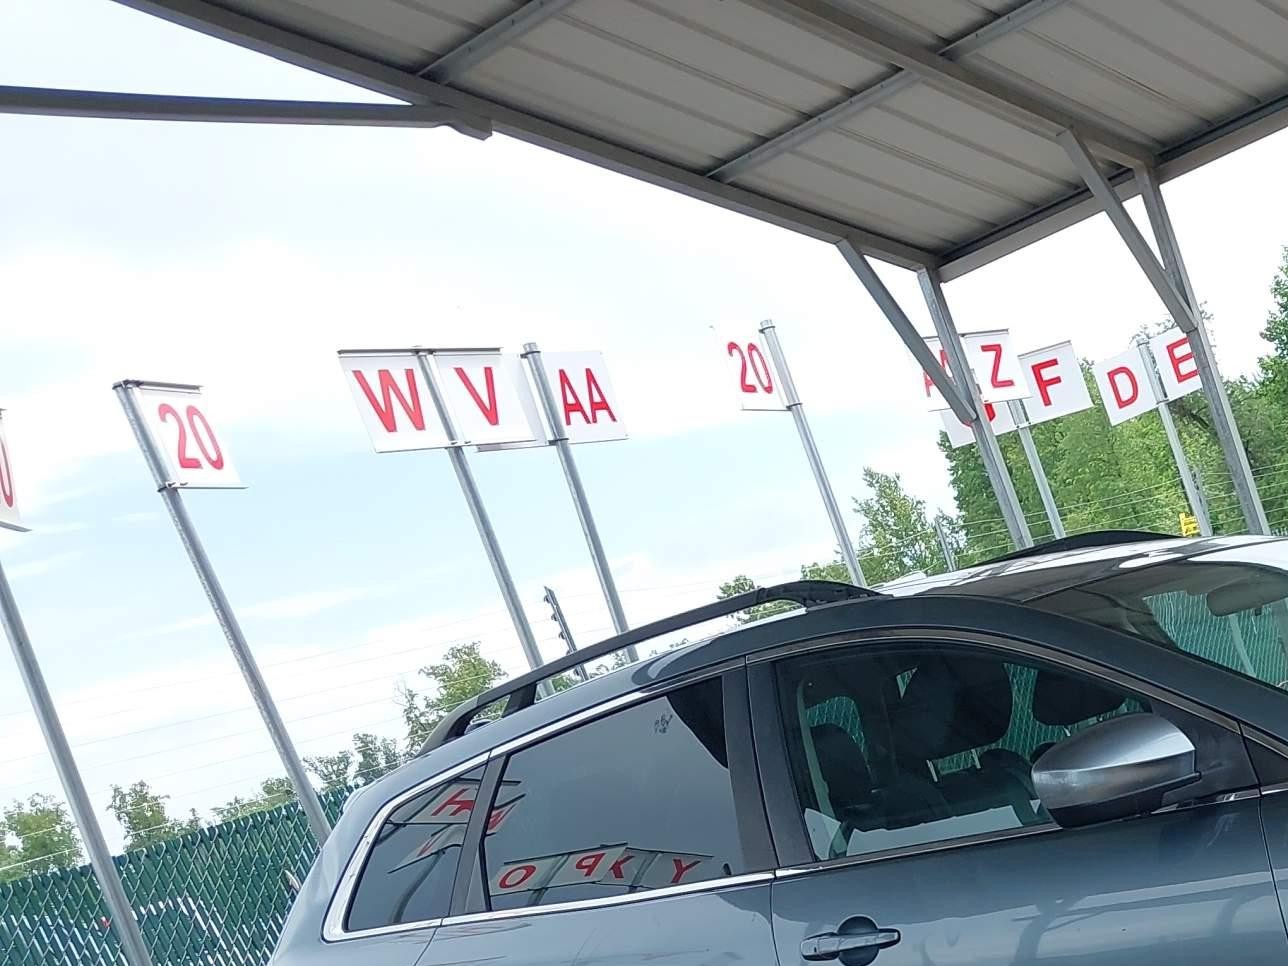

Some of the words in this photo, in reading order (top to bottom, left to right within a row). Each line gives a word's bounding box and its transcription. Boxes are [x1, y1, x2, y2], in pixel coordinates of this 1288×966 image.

[727, 341, 773, 394] 20
[980, 343, 1015, 388] Z
[1031, 358, 1063, 406] F
[1166, 336, 1200, 384] E
[353, 368, 426, 433] W
[454, 367, 500, 426] V
[559, 367, 617, 426] AA
[1107, 366, 1139, 409] D
[157, 403, 225, 471] 20
